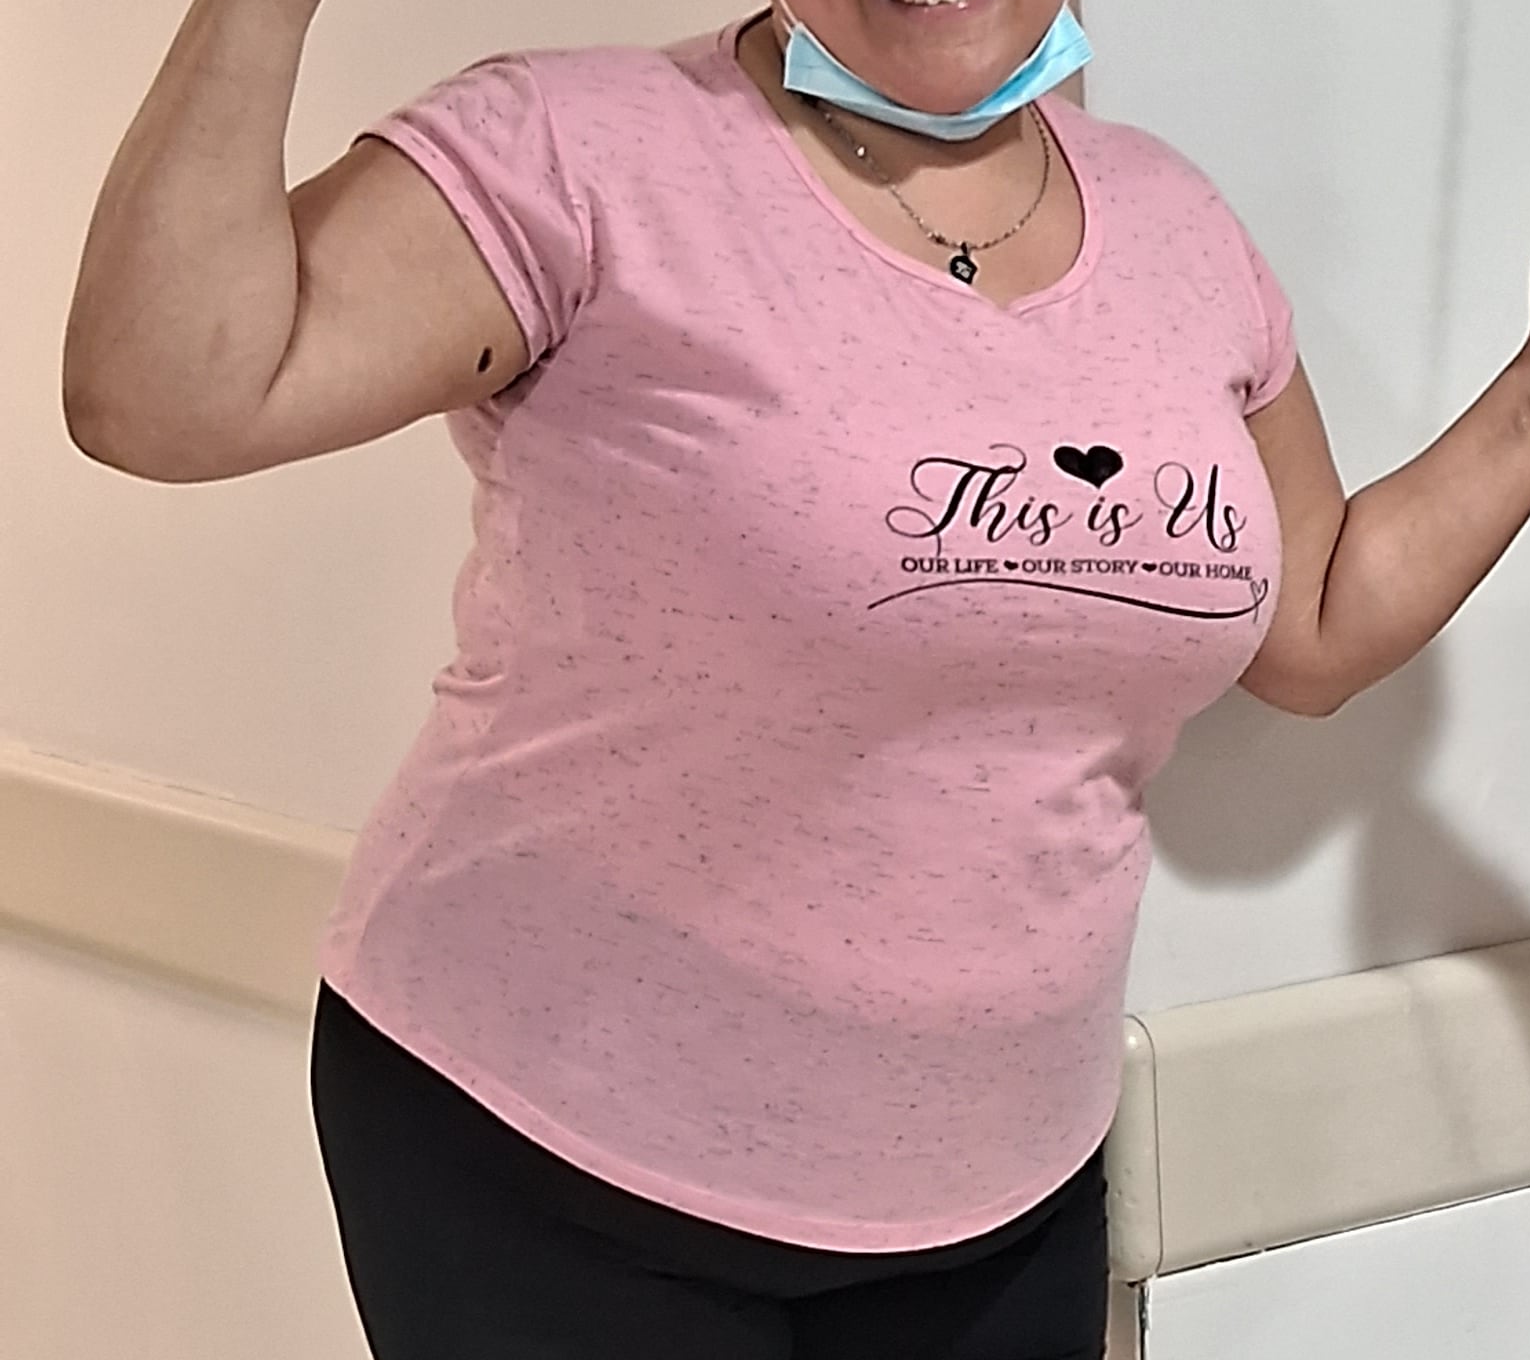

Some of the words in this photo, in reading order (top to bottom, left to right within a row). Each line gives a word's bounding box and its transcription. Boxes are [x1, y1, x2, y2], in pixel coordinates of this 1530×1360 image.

[886, 443, 1074, 557] This
[1087, 496, 1144, 547] is
[1153, 461, 1247, 553] Us
[901, 557, 949, 574] OUR
[954, 557, 999, 575] LIFE
[1021, 558, 1067, 575] OUR
[1071, 558, 1138, 575] STORY
[1158, 561, 1202, 577] OUR
[1205, 563, 1253, 581] HOME
